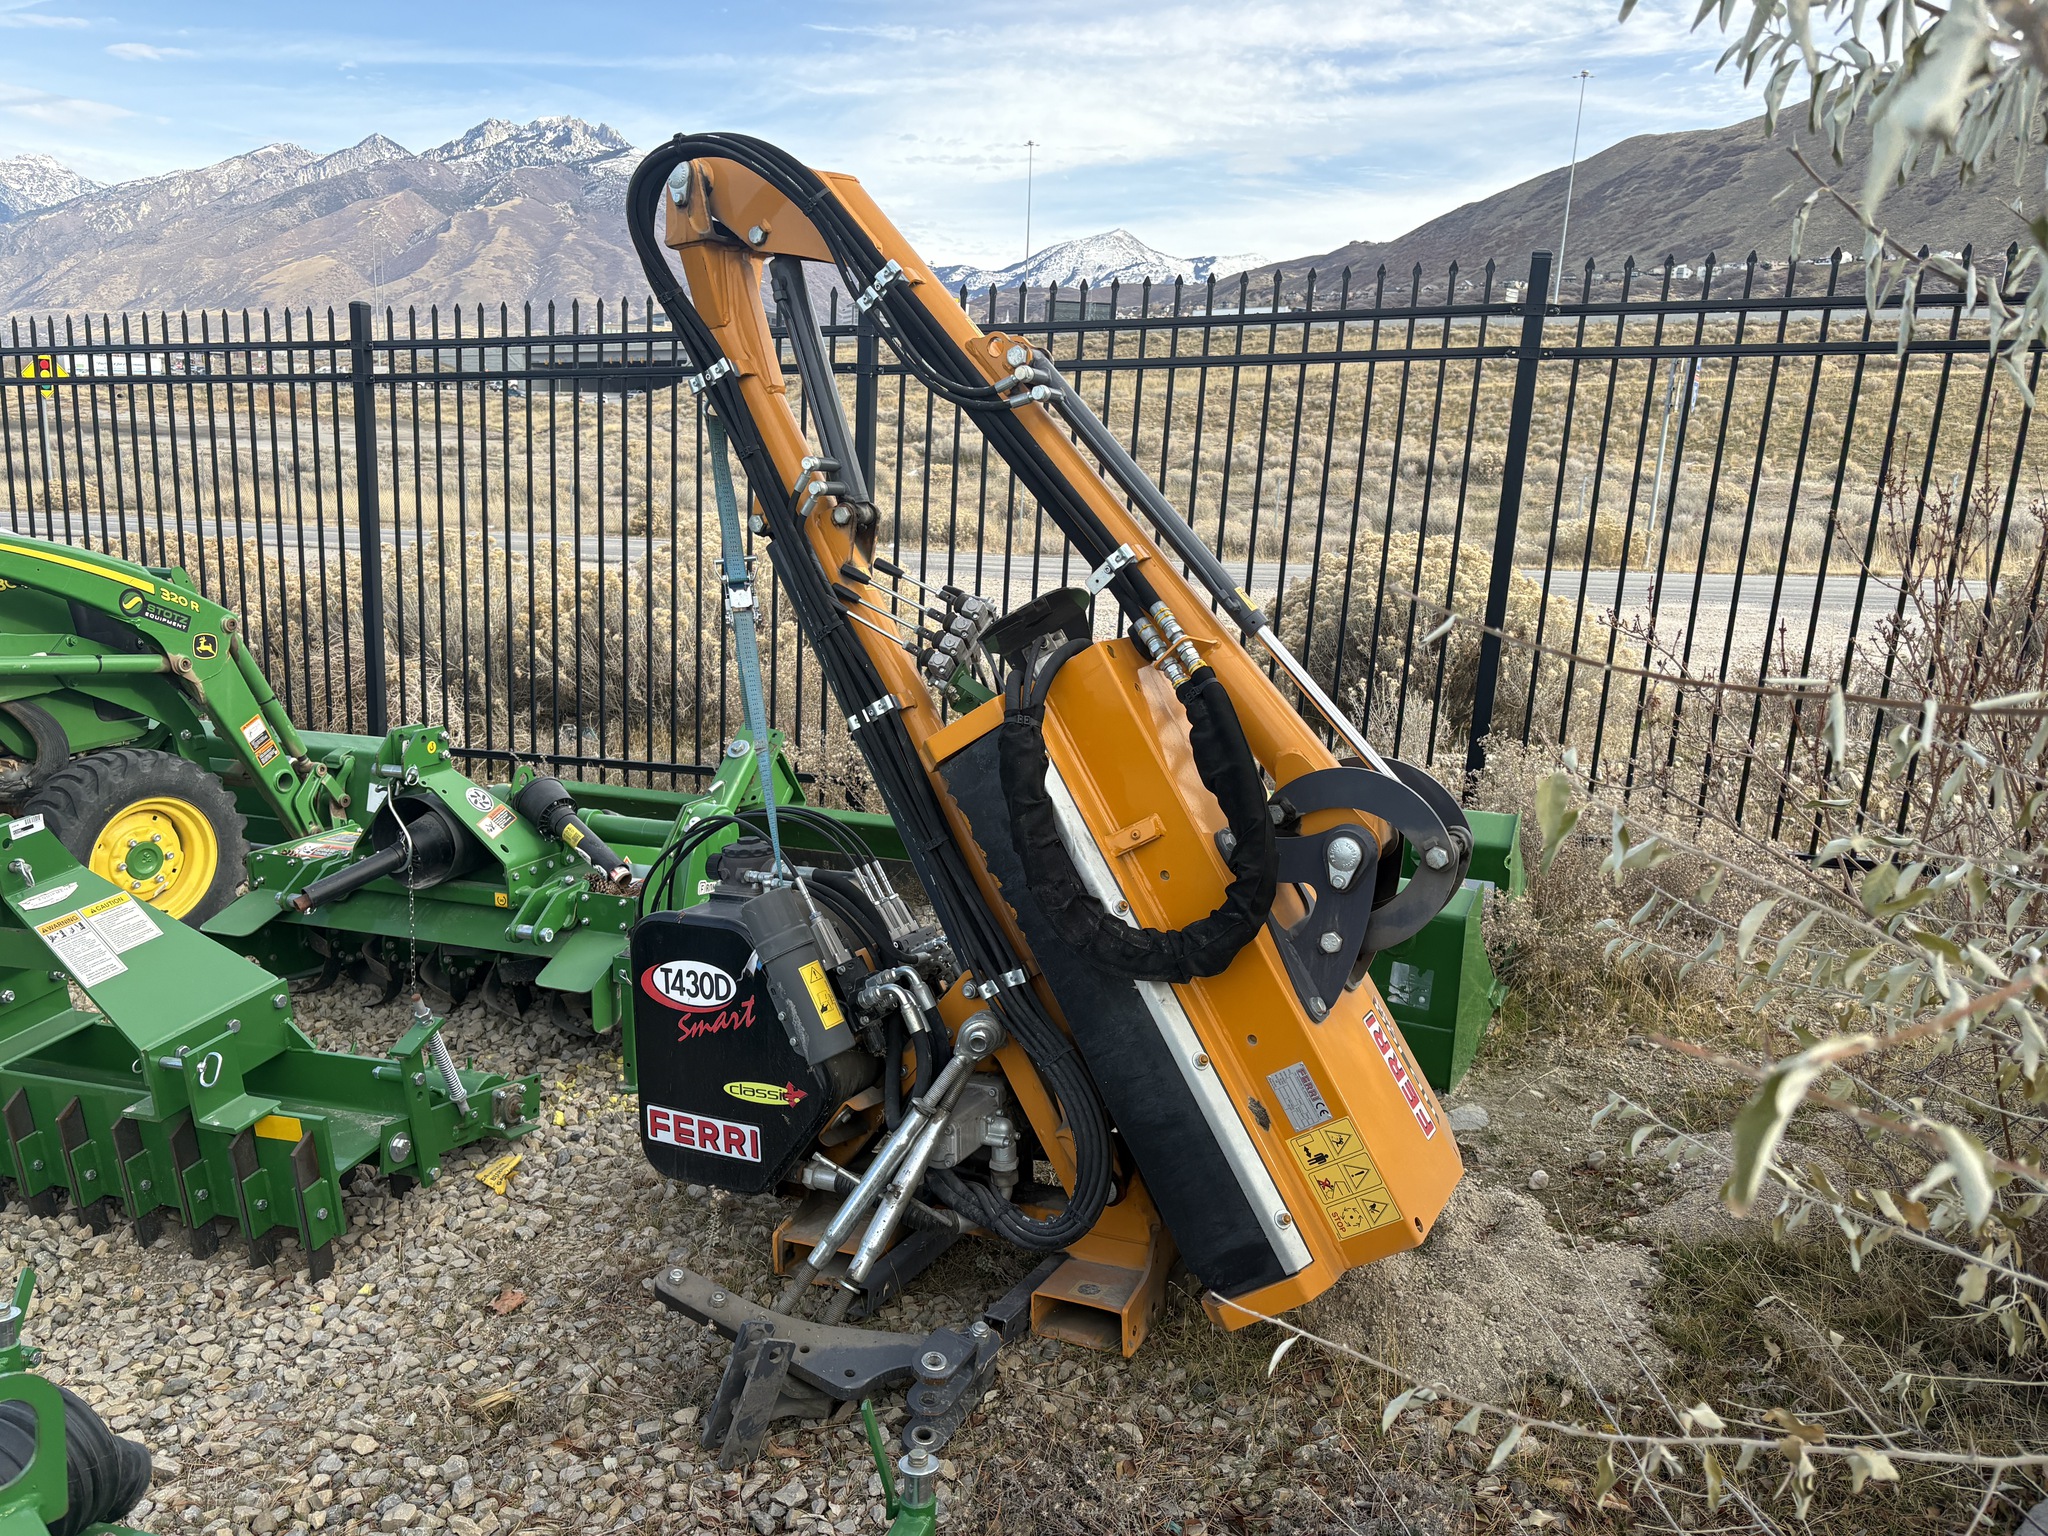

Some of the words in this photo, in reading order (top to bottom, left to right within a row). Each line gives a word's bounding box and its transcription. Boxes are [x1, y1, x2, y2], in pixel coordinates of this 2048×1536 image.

[160, 587, 188, 607] 320
[190, 600, 200, 612] R
[144, 612, 187, 630] EQUIPMENT
[146, 603, 189, 625] STOTZ
[95, 896, 124, 911] CAUTION
[46, 915, 79, 931] WARNING
[659, 966, 732, 1001] T430D
[677, 995, 756, 1042] Smart
[1296, 1068, 1321, 1102] FERRI
[1365, 1013, 1435, 1138] FERRI
[649, 1108, 760, 1160] FERRI
[1331, 1211, 1347, 1232] STOP
